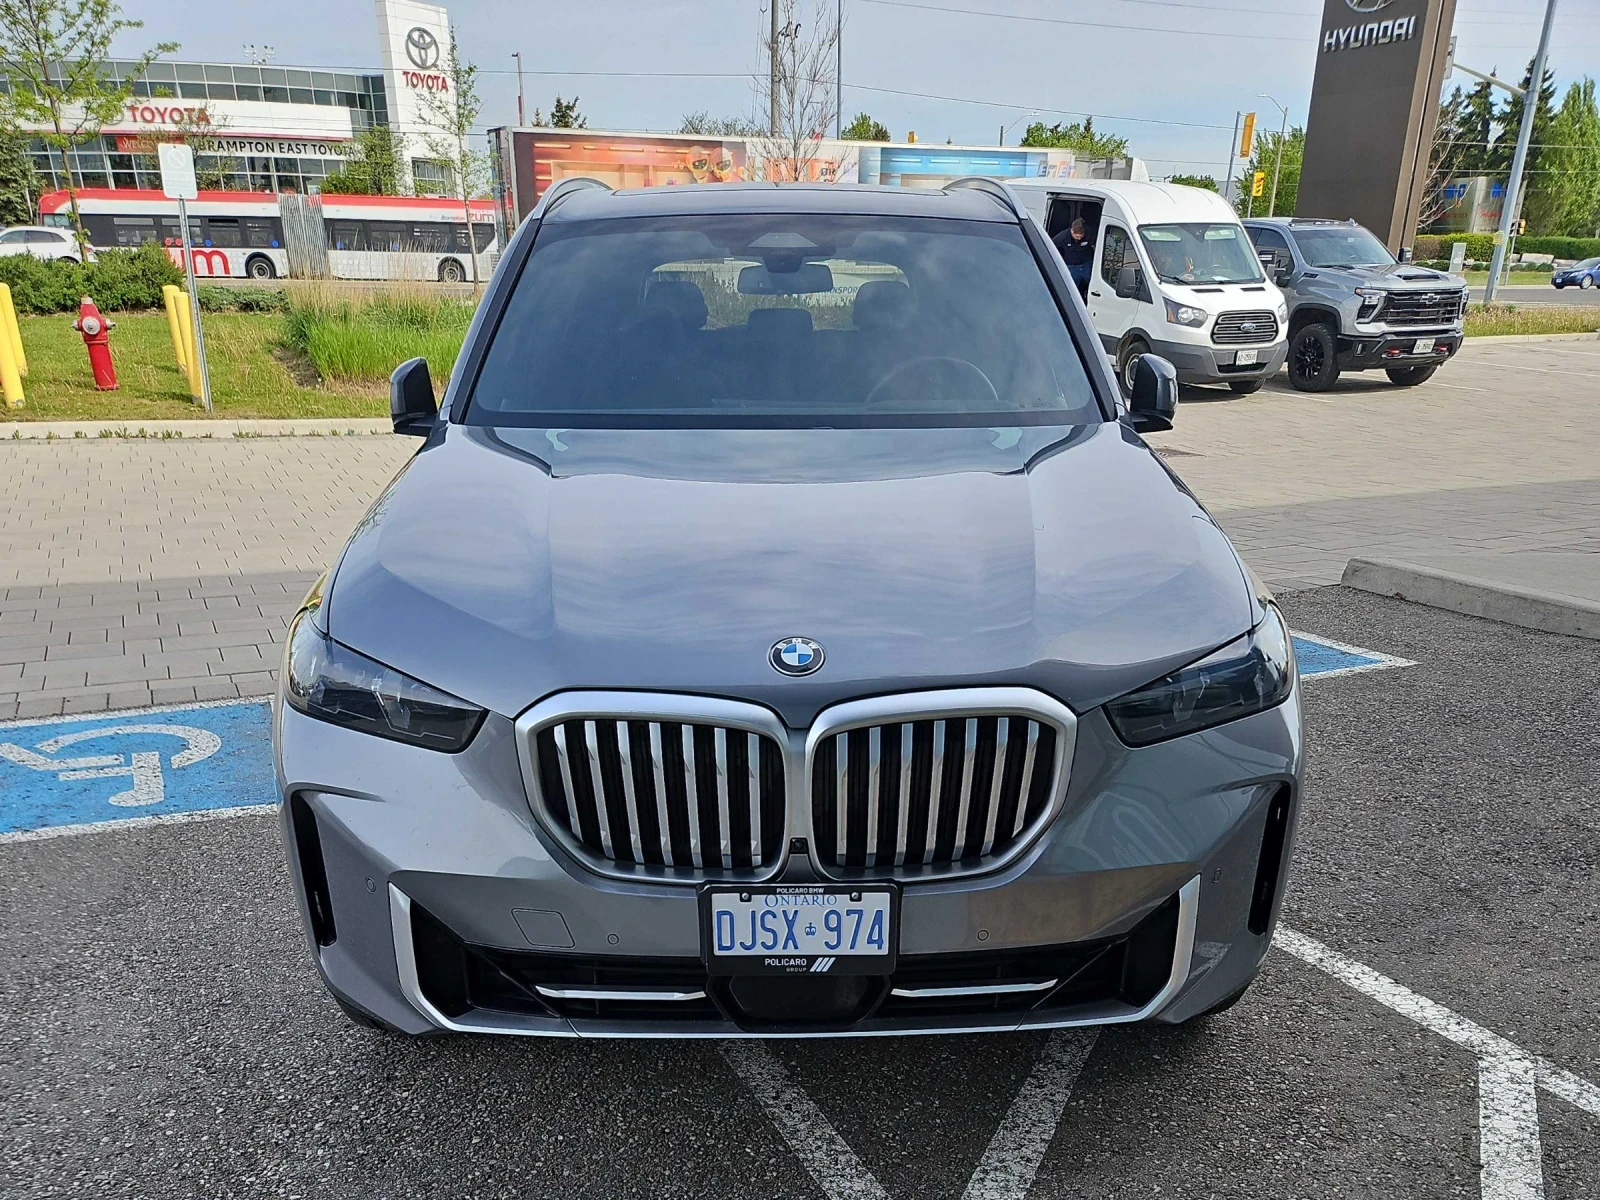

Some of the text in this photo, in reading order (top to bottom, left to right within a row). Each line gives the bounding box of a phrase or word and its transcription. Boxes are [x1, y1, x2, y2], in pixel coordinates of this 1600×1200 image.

[1323, 15, 1416, 53] HYUNDAI
[402, 70, 449, 93] TOYOTA
[127, 104, 212, 125] TOYOTA
[200, 139, 275, 154] BRAMPTON
[279, 142, 308, 155] EAST
[764, 894, 838, 908] ONTARIO
[715, 909, 885, 952] DJSX 974
[764, 958, 807, 966] POLICARO
